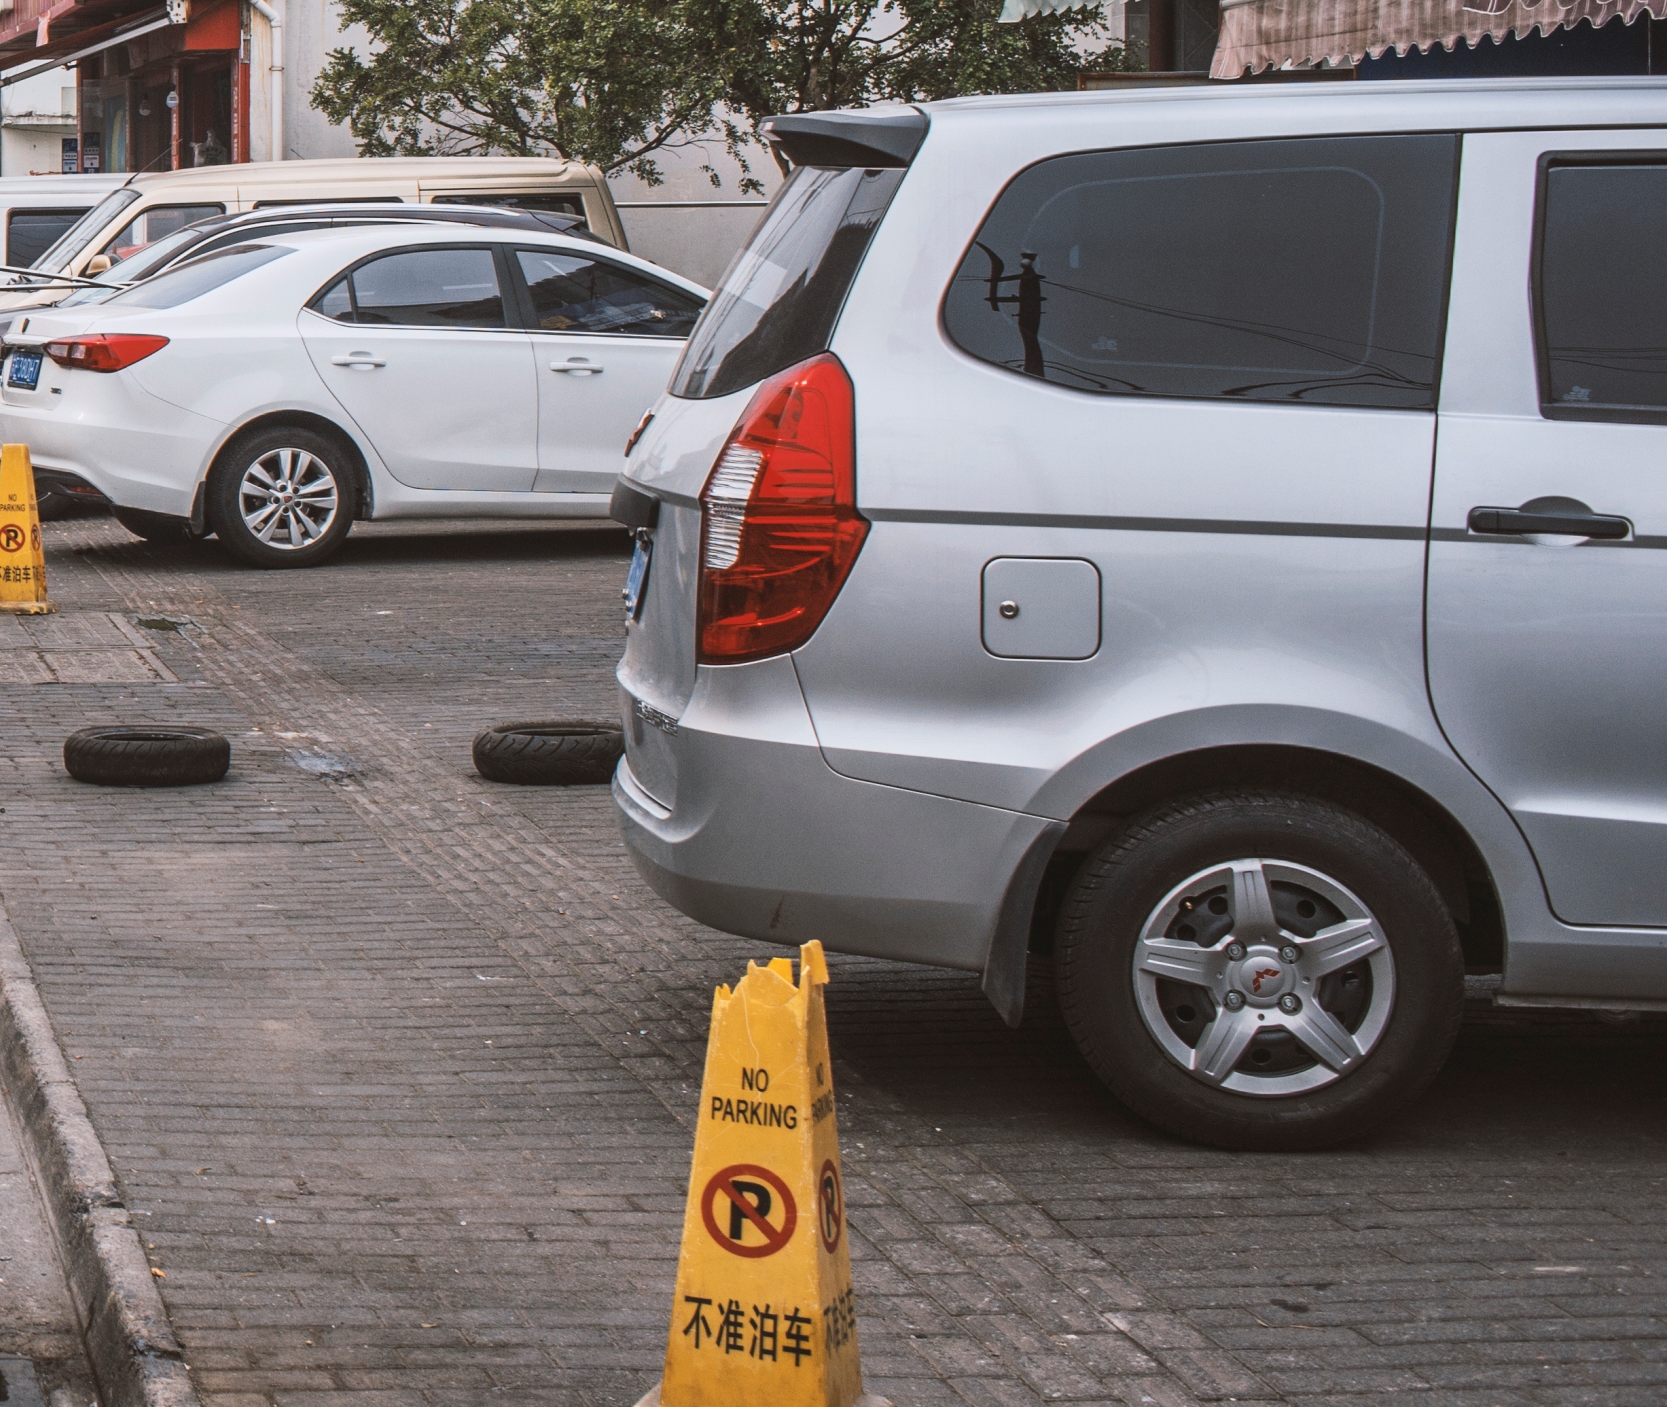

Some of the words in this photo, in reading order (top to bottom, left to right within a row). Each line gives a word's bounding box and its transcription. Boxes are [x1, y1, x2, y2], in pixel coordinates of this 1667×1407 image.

[0, 503, 26, 512] PARKING
[8, 494, 18, 502] NO
[741, 1066, 770, 1093] NO
[710, 1096, 798, 1130] PARKING
[683, 1294, 813, 1368] 不准泊车
